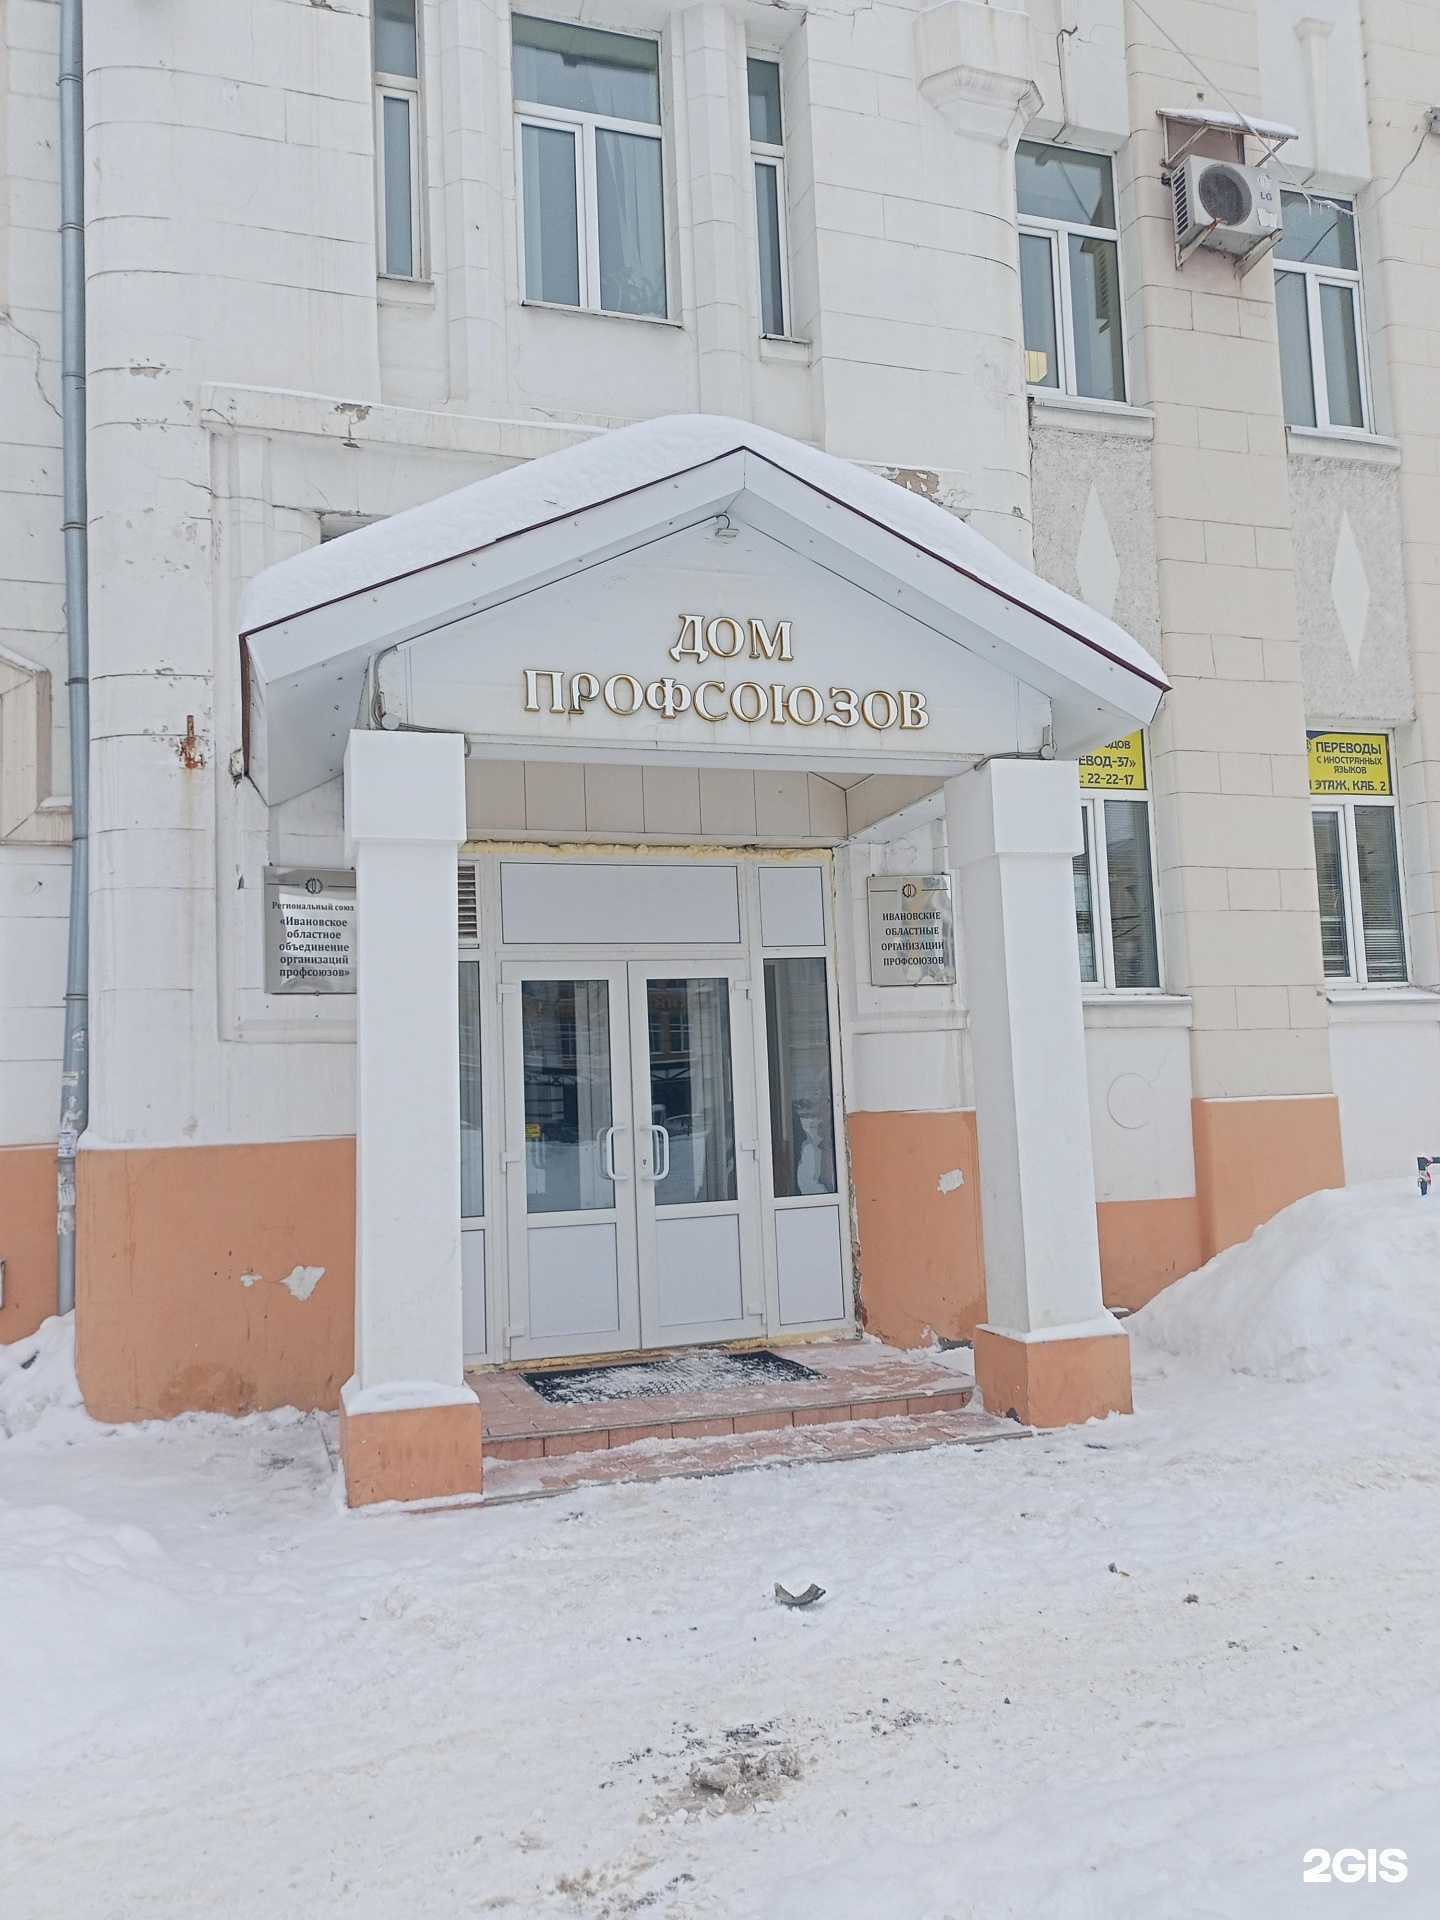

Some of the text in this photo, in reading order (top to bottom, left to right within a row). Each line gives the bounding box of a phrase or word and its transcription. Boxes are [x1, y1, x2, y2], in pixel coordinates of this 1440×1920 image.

[669, 614, 793, 664] ДОМ
[523, 669, 930, 731] ПРОФСОЮЗОВ
[1104, 740, 1131, 750] ДОВ
[1315, 741, 1382, 755] ПЕРЕВОДЫ
[1317, 756, 1383, 766] С ИНОСТРАННЫХ
[1334, 766, 1367, 774] ЯЗЫКОВ
[1087, 773, 1134, 785] 22-22-17
[1314, 780, 1350, 791] ЭТАЖ,
[1352, 780, 1378, 791] КАБ.
[1380, 781, 1386, 791] 2
[272, 901, 333, 911] Региональный
[280, 916, 348, 927] «Ивановское
[882, 912, 941, 921] ИВАНОВСКИЕ
[286, 929, 341, 939] областное
[885, 927, 939, 936] ОБЛАСТНЫЕ
[279, 942, 350, 952] объединение
[881, 941, 944, 951] ОРГАНИЗАЦИИ
[280, 955, 349, 966] организаций
[883, 957, 944, 966] ПРОФСОЮЗОВ
[279, 967, 350, 979] профсоюзов»
